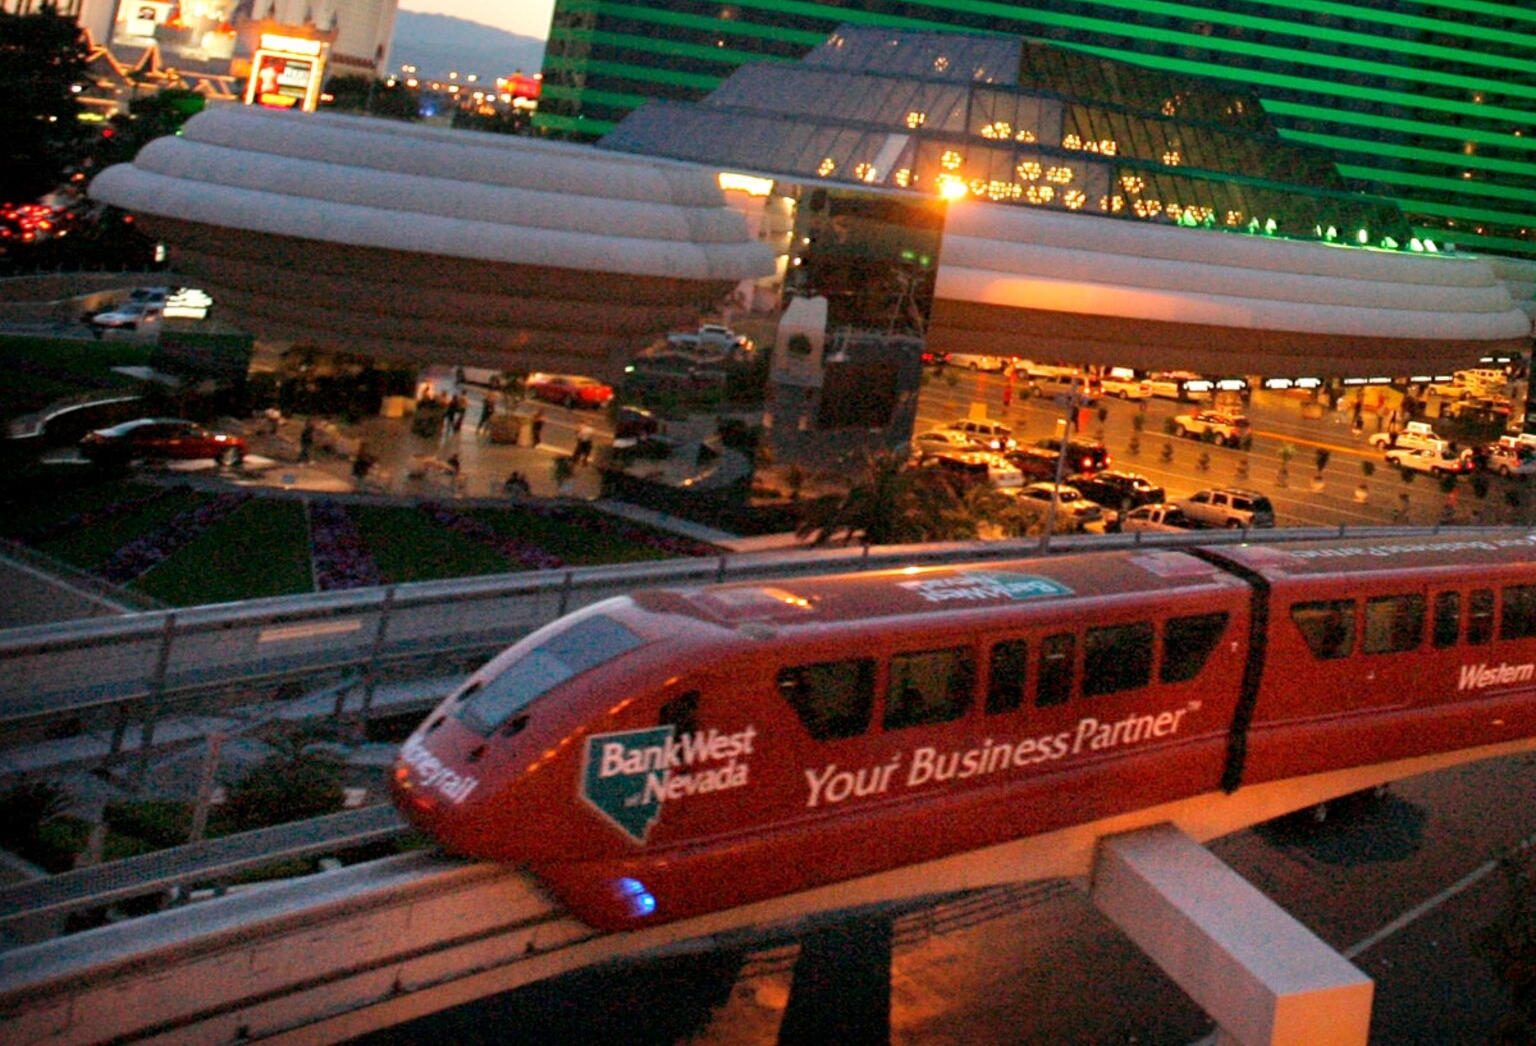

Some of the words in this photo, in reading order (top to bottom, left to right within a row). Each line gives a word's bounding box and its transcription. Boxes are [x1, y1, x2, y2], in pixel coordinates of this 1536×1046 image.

[1457, 657, 1535, 690] Western
[599, 726, 757, 777] BankWest
[804, 761, 902, 808] Your
[907, 731, 1069, 788] Business
[641, 760, 748, 805] Nevada
